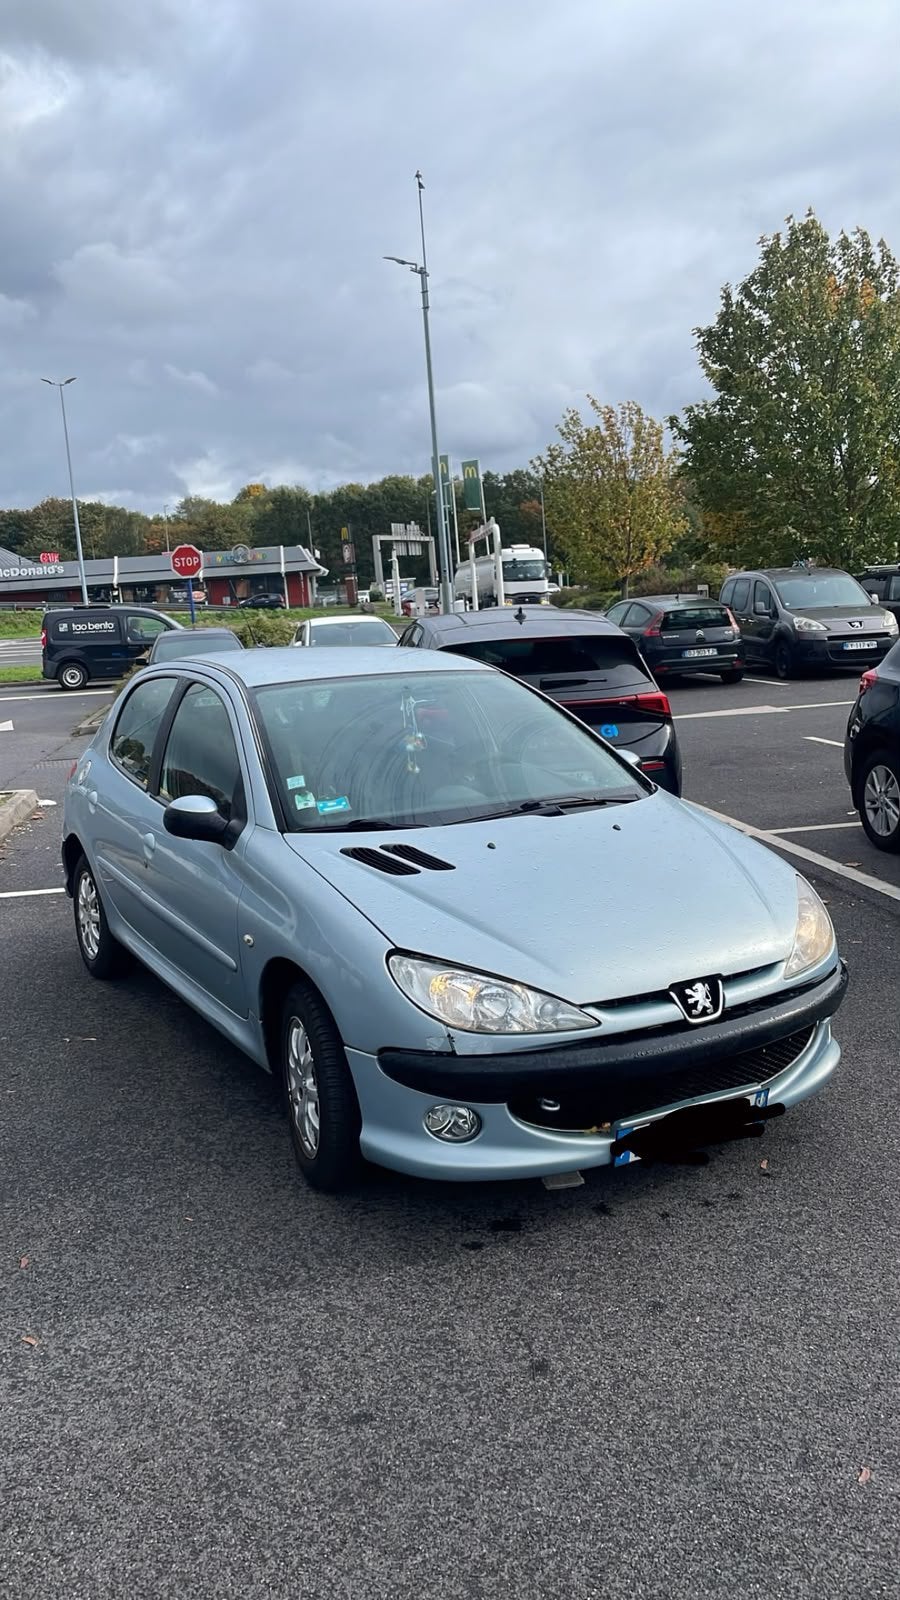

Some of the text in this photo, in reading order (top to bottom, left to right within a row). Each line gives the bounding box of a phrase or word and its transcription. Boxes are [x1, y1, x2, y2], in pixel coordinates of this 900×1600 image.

[174, 557, 200, 567] STOP
[0, 565, 65, 577] cDonald's
[72, 621, 114, 631] tao bento
